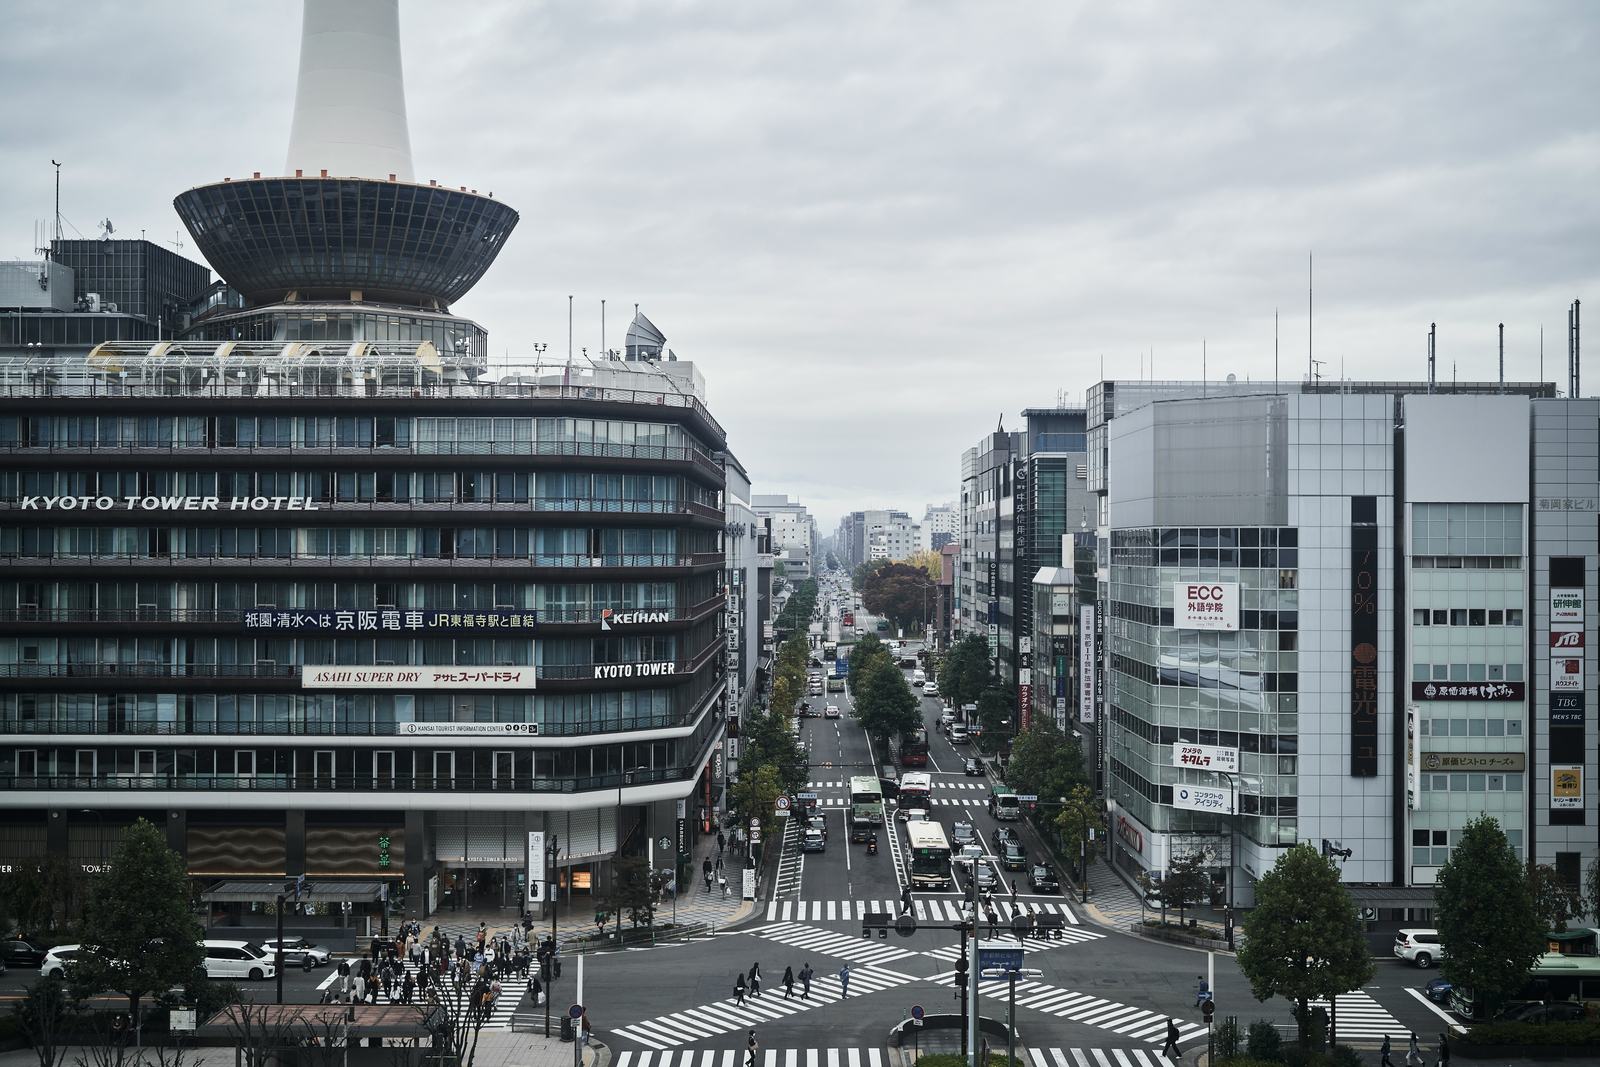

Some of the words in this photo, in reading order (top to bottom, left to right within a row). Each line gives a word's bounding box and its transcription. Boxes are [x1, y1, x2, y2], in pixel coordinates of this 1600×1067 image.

[21, 495, 114, 511] KYOTO
[126, 495, 220, 511] TOWER
[230, 496, 319, 511] HOTEL
[1187, 585, 1224, 601] ECC
[1187, 602, 1224, 613] 外語学院
[1553, 598, 1582, 609] 研伸館
[244, 612, 332, 628] 祇園・清水へは
[334, 610, 425, 631] 京阪電車
[428, 613, 535, 628] JR東福寺駅と直結
[1554, 632, 1580, 648] JTB
[594, 663, 632, 679] KYOTO
[635, 662, 675, 677] TOWER
[313, 672, 352, 683] ASAHI
[354, 672, 394, 683] SUPER
[396, 672, 423, 683] DRY
[432, 672, 522, 683] アサヒスーパードライ
[1557, 698, 1578, 707] TBC
[417, 725, 434, 733] KANSAI
[434, 725, 456, 733] TOURIST
[456, 725, 486, 733] INFORMATION
[487, 725, 505, 733] CENTER
[1181, 747, 1203, 755] カメラの
[1181, 755, 1211, 767] キタムラ
[1194, 791, 1224, 800] コンタクトの
[1194, 798, 1224, 808] アイシティ
